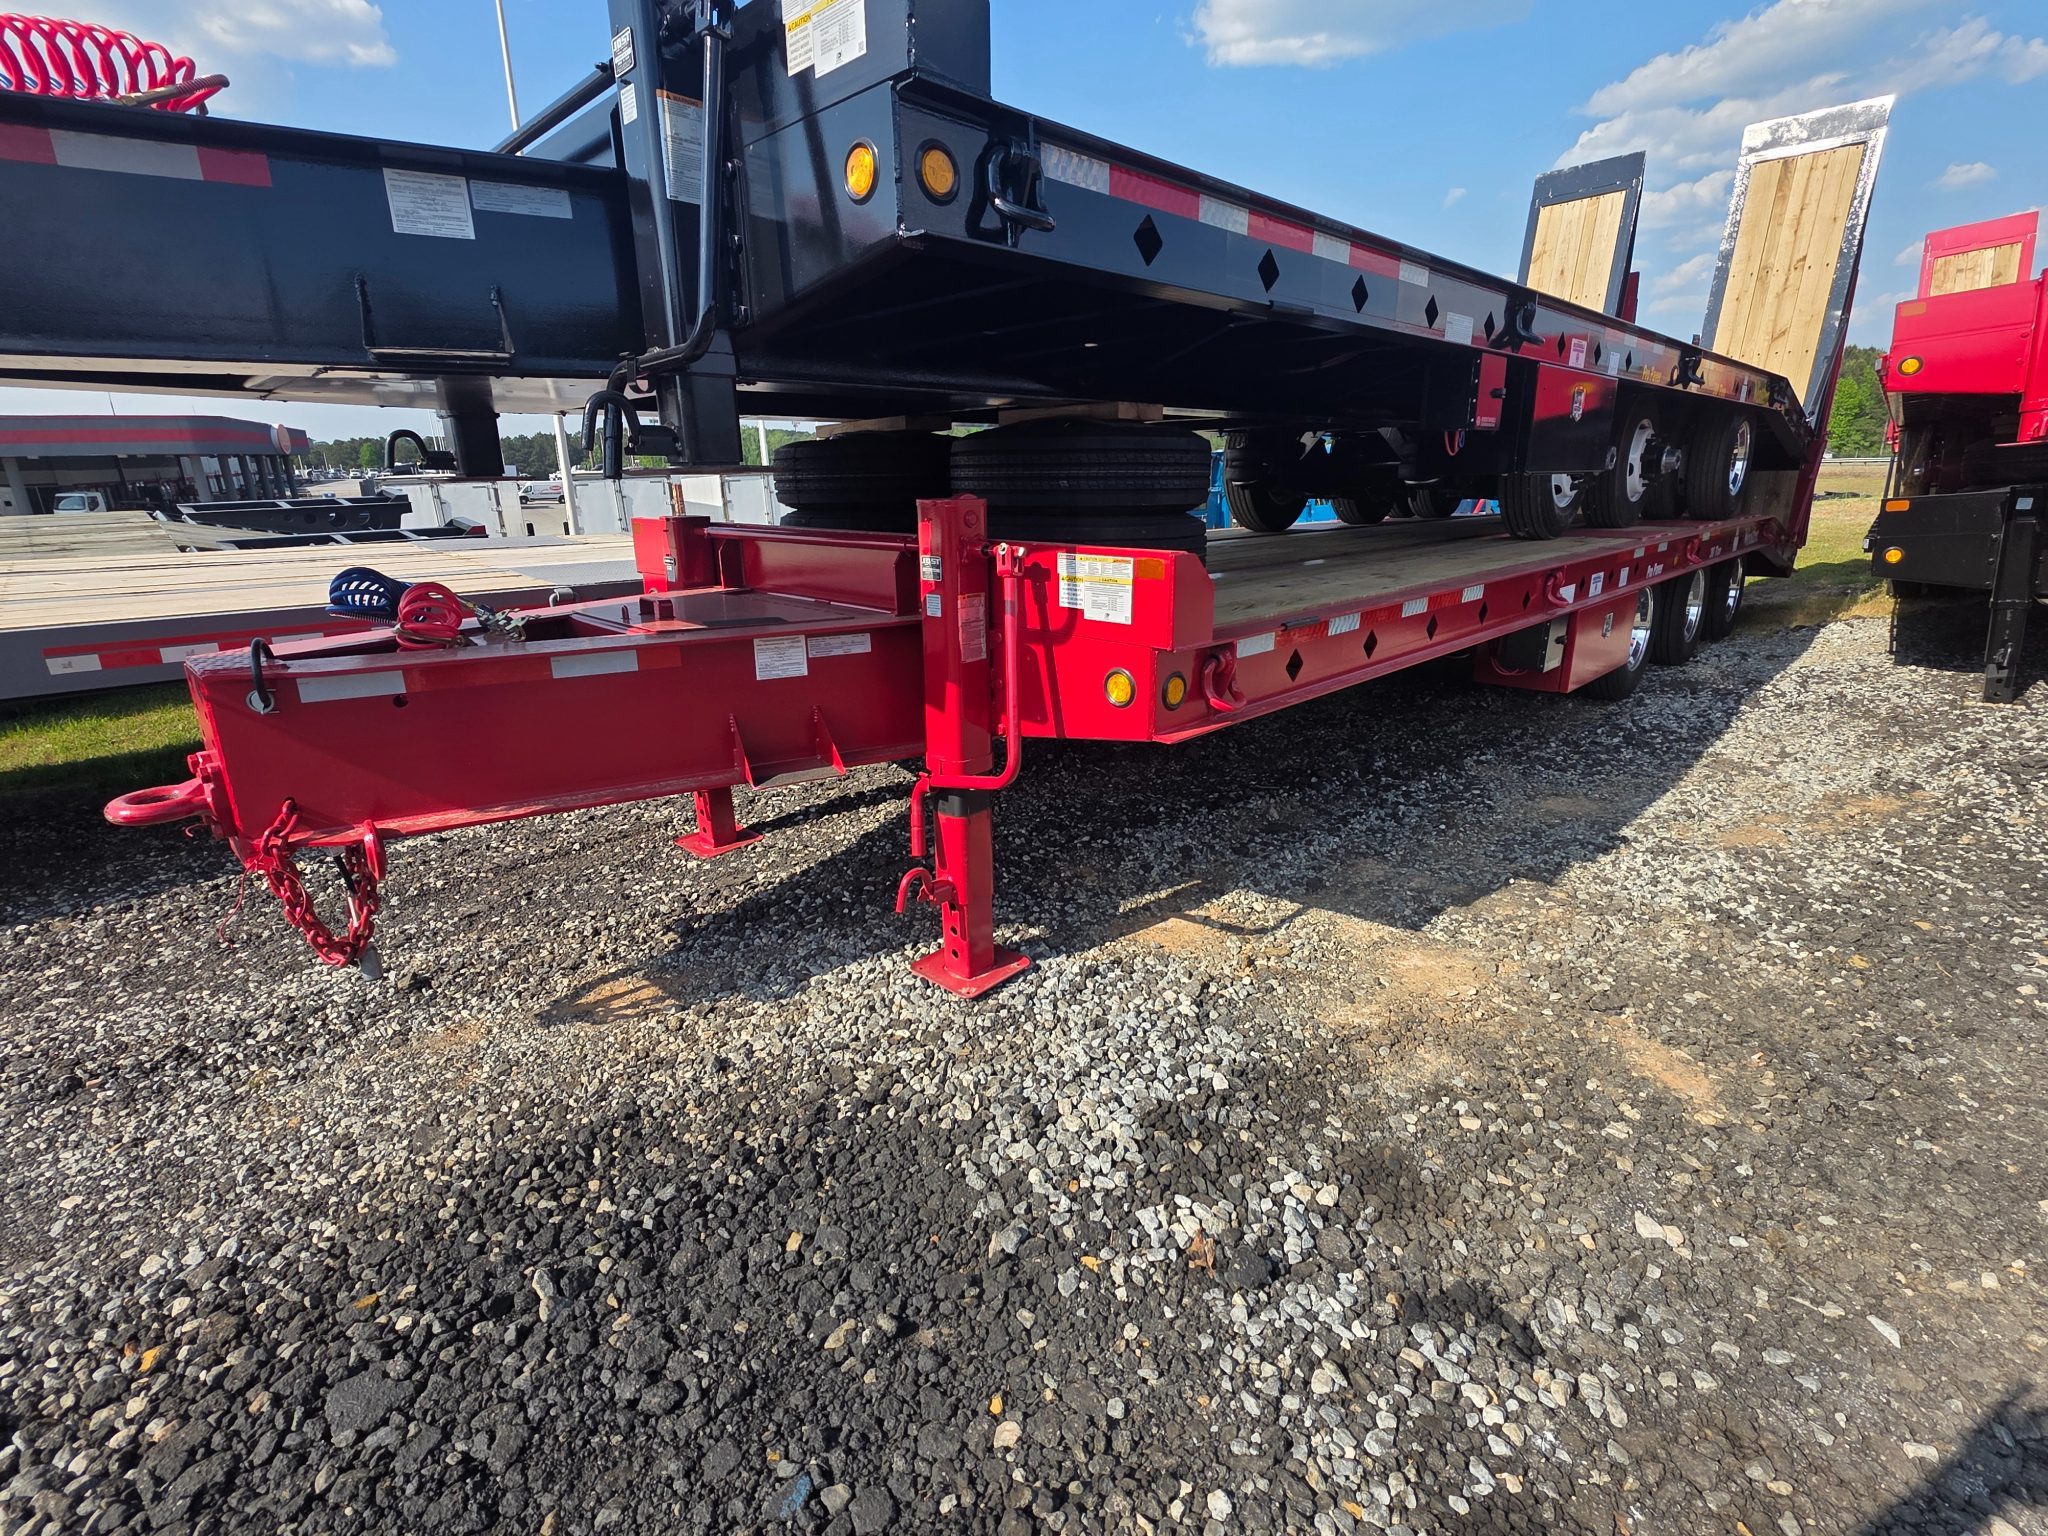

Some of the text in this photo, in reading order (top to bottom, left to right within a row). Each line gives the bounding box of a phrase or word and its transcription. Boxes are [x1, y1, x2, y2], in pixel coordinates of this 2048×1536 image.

[791, 12, 812, 30] CAUTION
[613, 31, 630, 52] JOST
[922, 557, 940, 565] JOST
